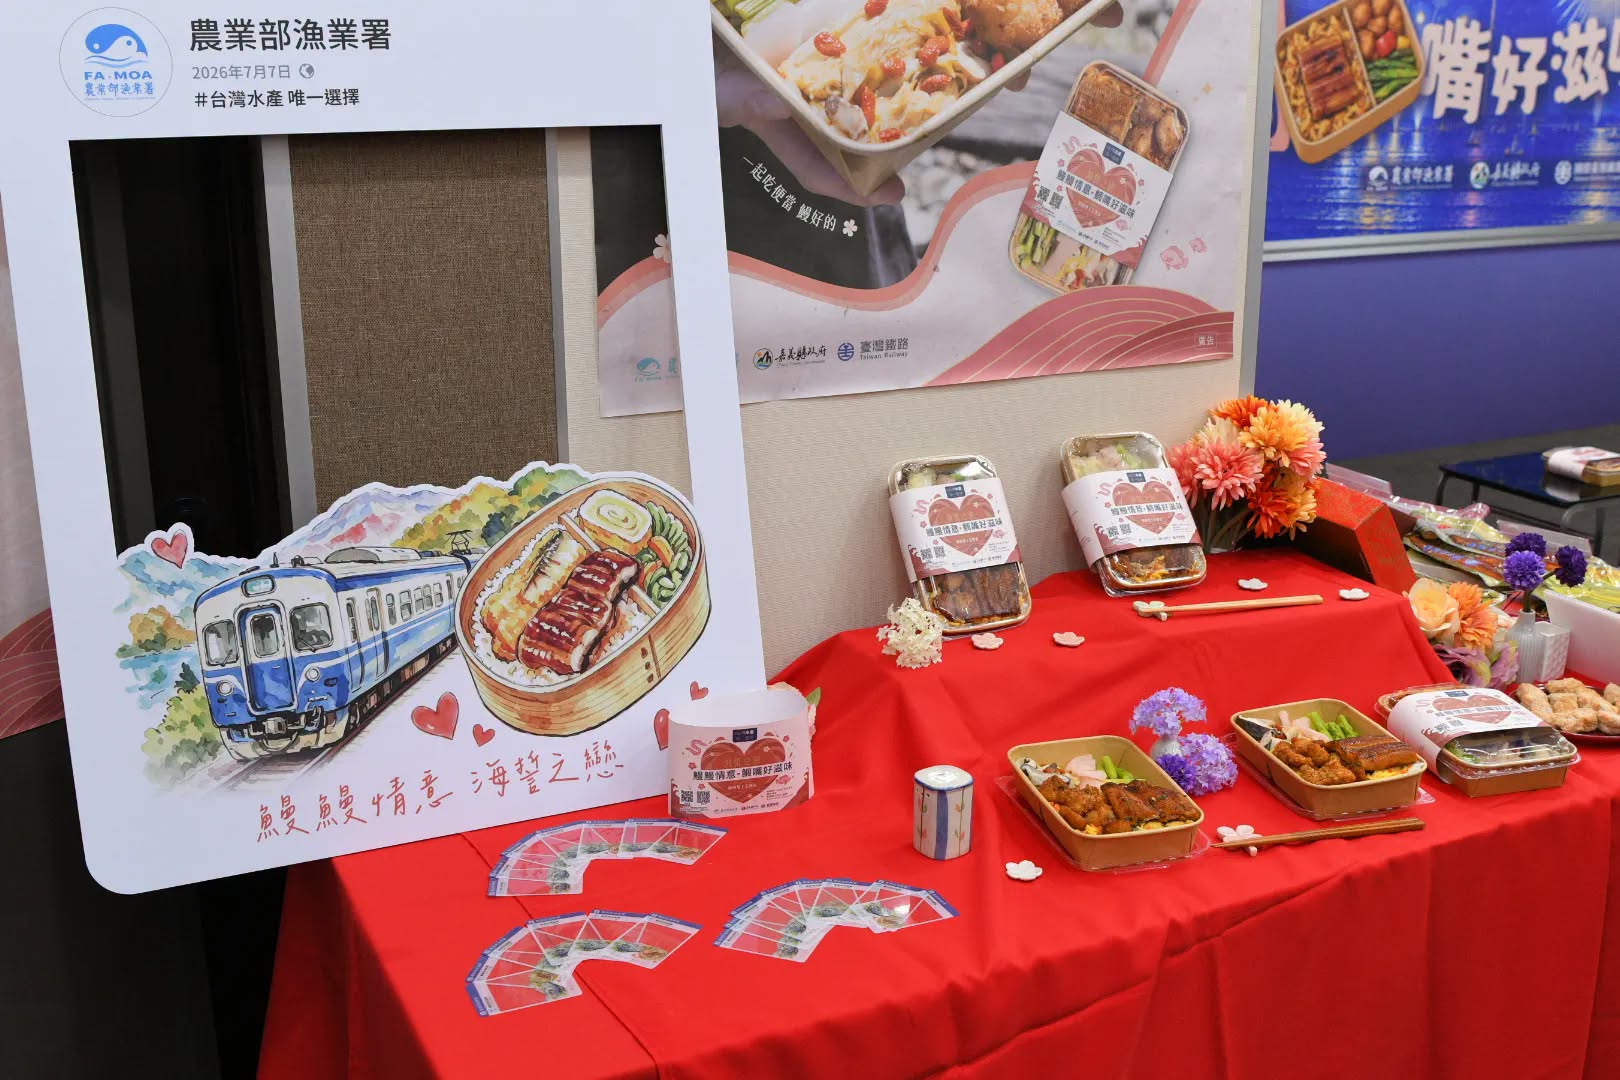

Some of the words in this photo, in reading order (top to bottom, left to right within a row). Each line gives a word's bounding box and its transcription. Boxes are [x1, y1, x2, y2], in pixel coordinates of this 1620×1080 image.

[190, 18, 392, 51] 農業部漁業署
[191, 64, 291, 80] 2026年7月7日
[194, 89, 284, 109] #台灣水產
[288, 88, 360, 106] 唯一選擇
[743, 156, 797, 212] 一起吃便當
[796, 203, 837, 232] 鰻好的
[860, 337, 909, 353] 臺灣鐵路
[860, 353, 882, 361] Taiwan
[885, 351, 908, 360] Railway
[257, 769, 453, 842] 鰻鰻情意
